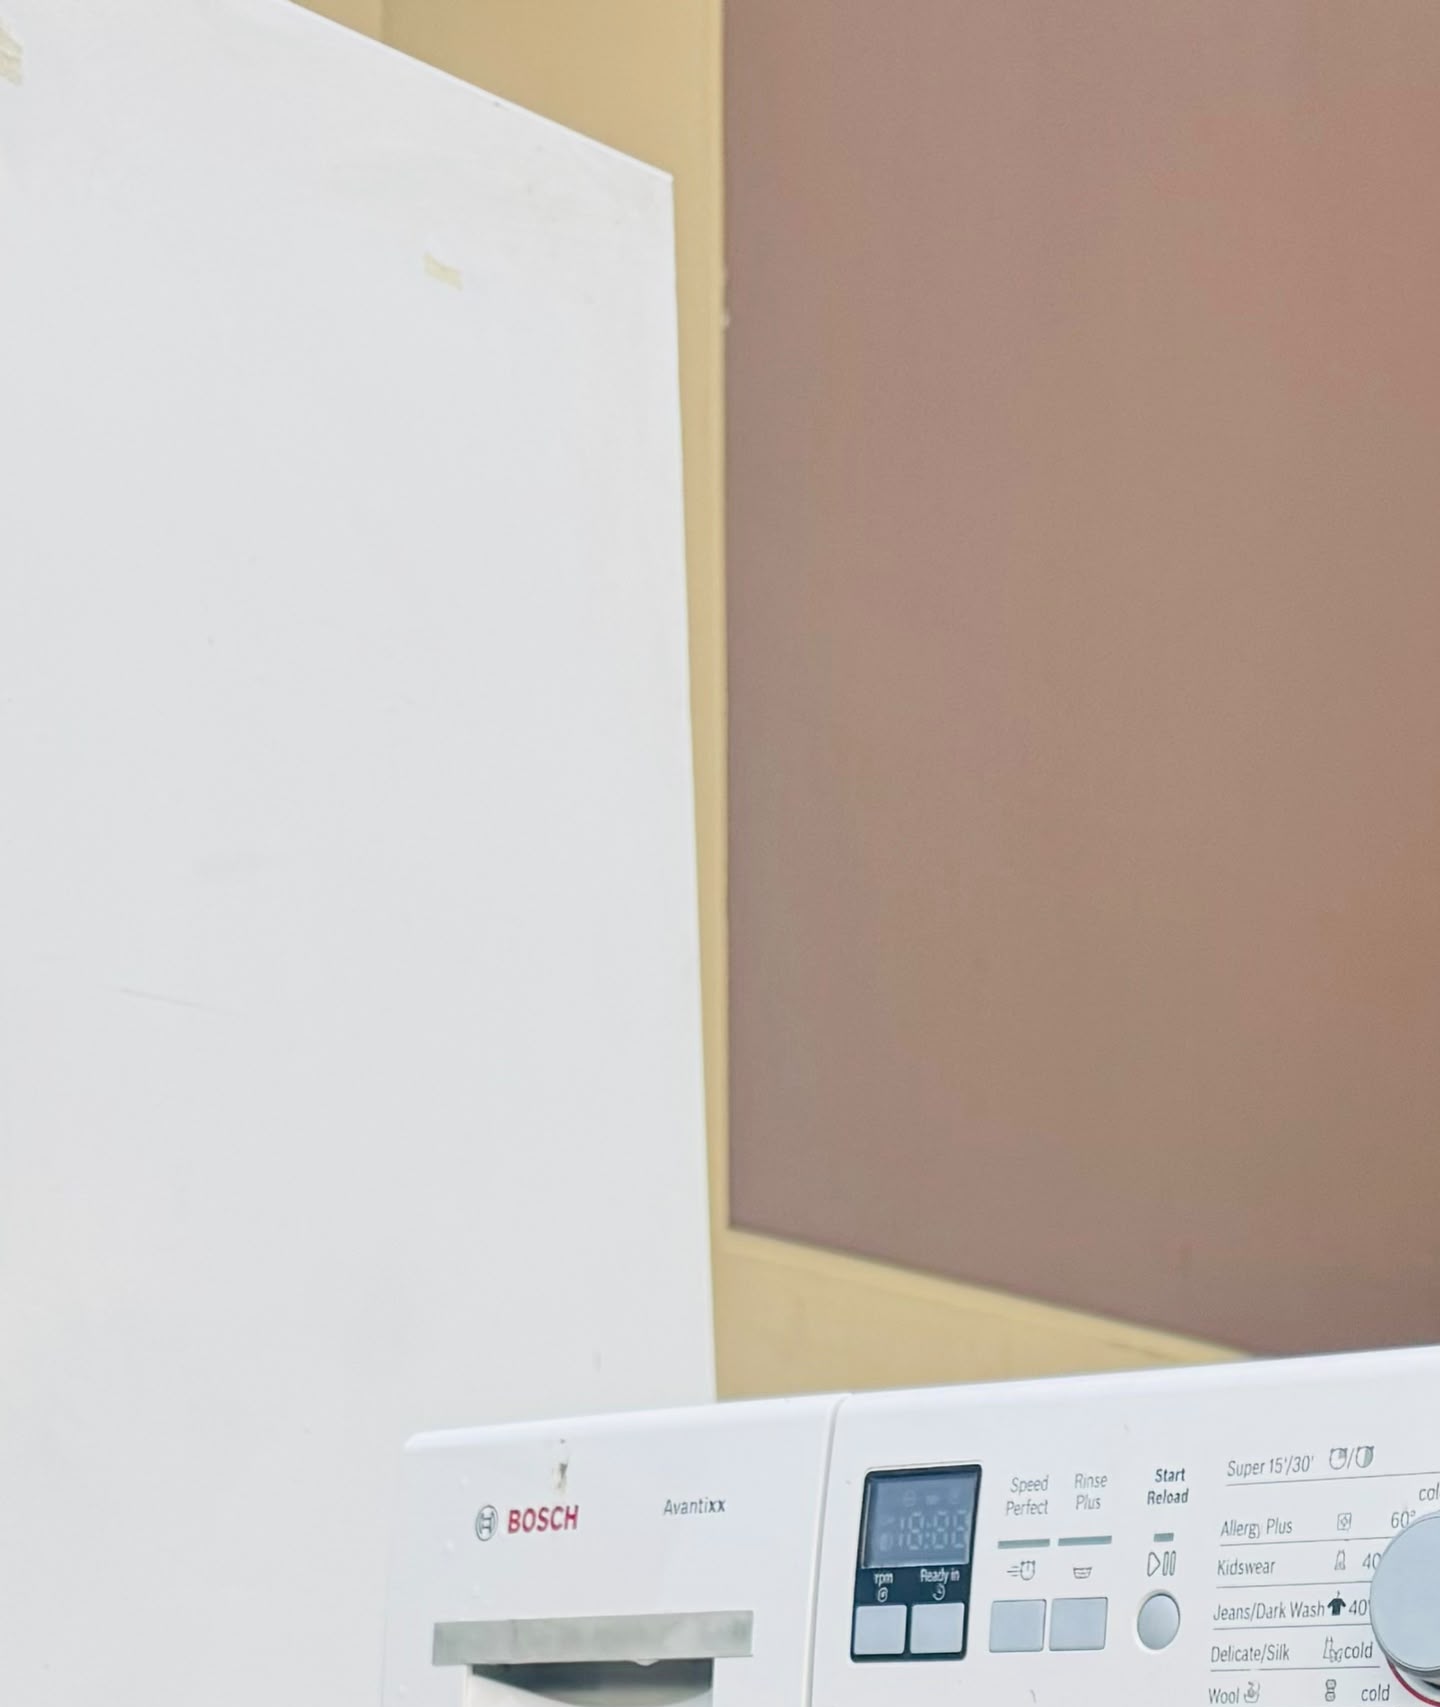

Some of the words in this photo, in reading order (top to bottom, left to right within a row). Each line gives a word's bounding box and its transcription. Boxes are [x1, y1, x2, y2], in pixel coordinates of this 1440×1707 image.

[1154, 1467, 1186, 1483] Start
[1227, 1459, 1265, 1479] Super
[1010, 1475, 1049, 1496] Speed
[1074, 1473, 1108, 1489] Rinse
[1075, 1494, 1101, 1511] Plus
[1147, 1488, 1189, 1506] Reload
[664, 1498, 726, 1517] Avantixx
[1005, 1499, 1048, 1517] Perfect
[508, 1505, 579, 1534] BOSCH
[1266, 1517, 1293, 1535] Plus
[1390, 1510, 1416, 1529] 60°
[920, 1568, 948, 1585] Ready
[950, 1568, 961, 1582] in
[1216, 1558, 1276, 1577] Kidswear
[874, 1572, 893, 1586] rpm
[1213, 1602, 1287, 1622] Jeans/Dark
[1290, 1600, 1325, 1619] Wash
[1349, 1599, 1370, 1616] 40
[1210, 1643, 1290, 1664] Delicate/Silk
[1344, 1641, 1373, 1659] cold
[1208, 1686, 1240, 1705] Wool
[1361, 1684, 1390, 1702] cold
